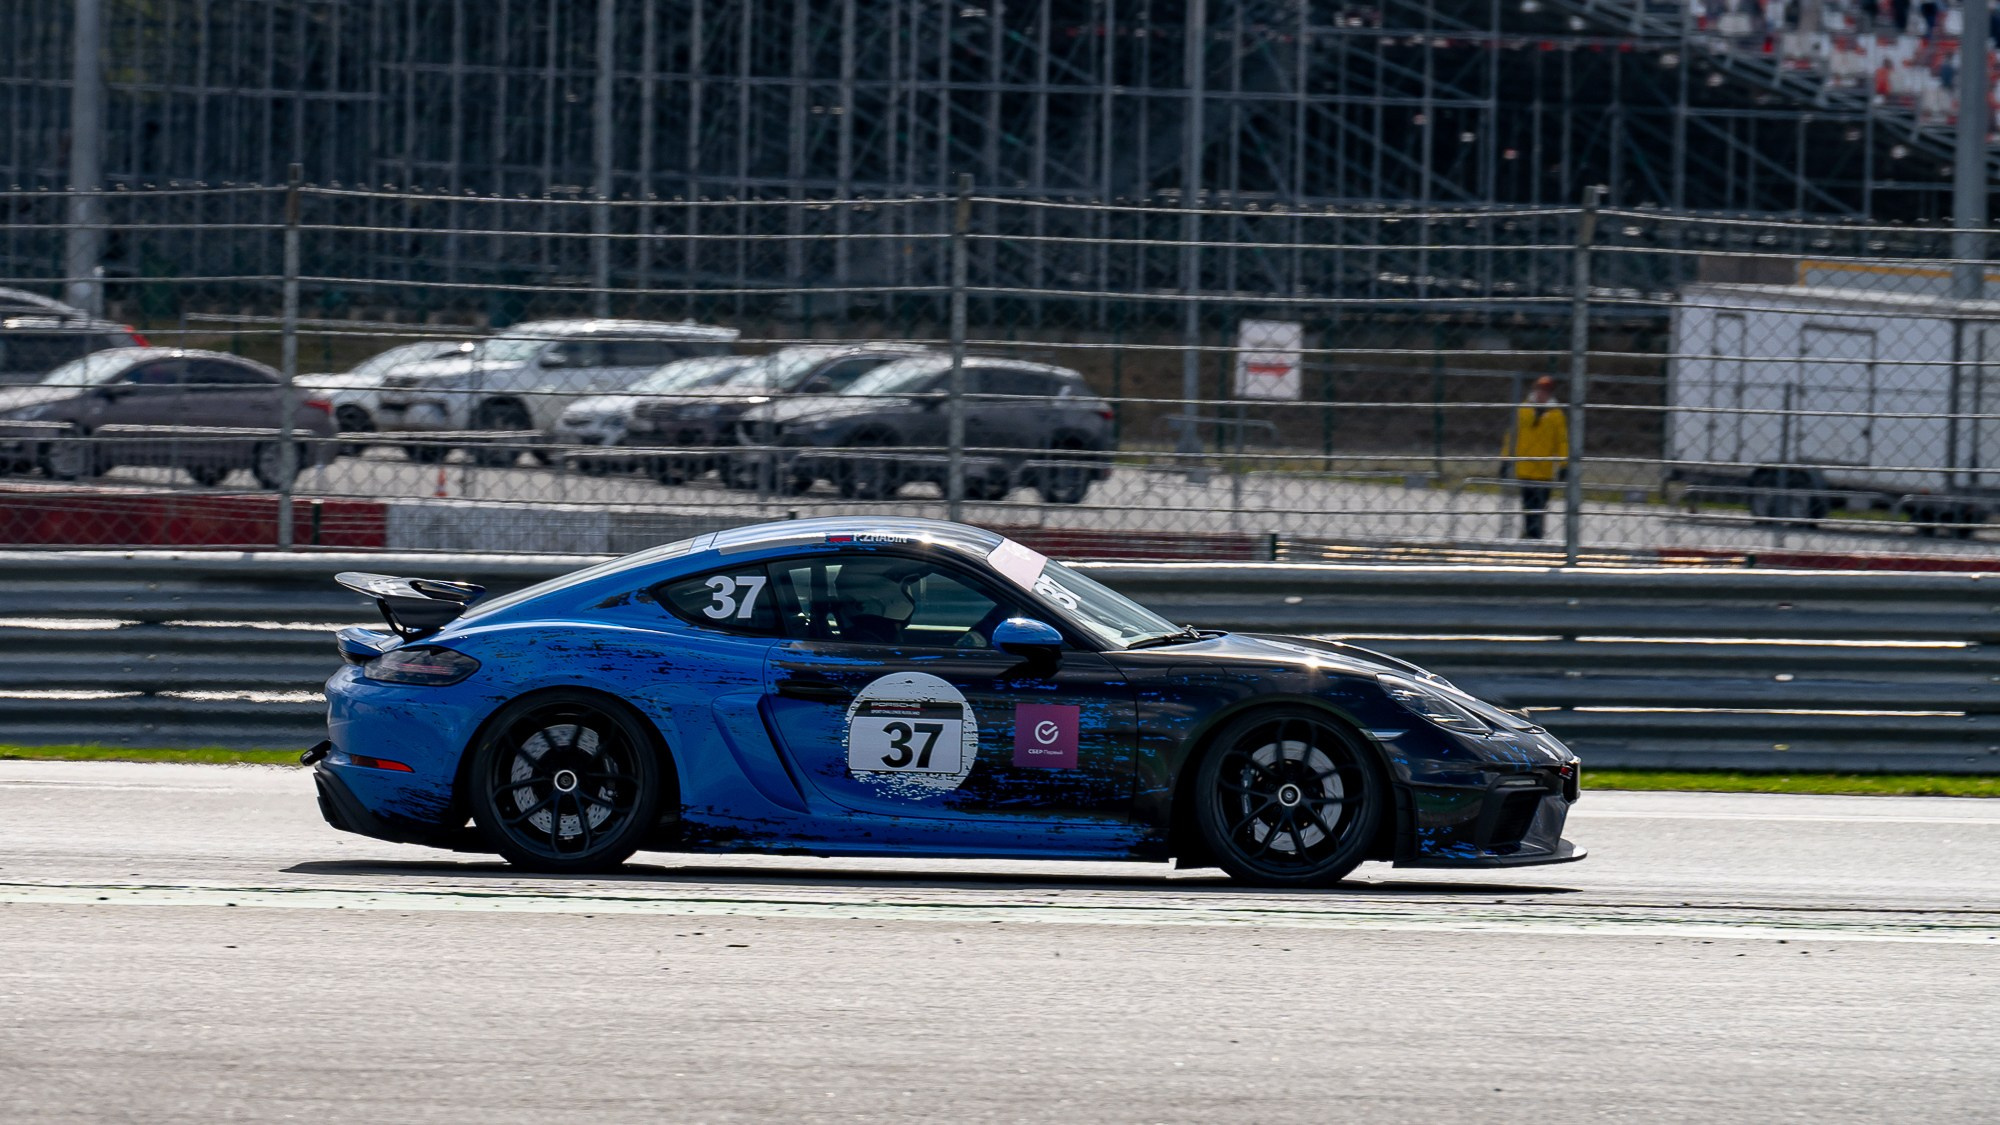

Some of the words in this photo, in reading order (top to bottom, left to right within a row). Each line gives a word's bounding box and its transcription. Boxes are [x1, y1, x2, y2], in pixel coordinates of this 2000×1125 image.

[703, 575, 767, 619] 37
[1034, 573, 1082, 611] 37
[881, 721, 944, 769] 37
